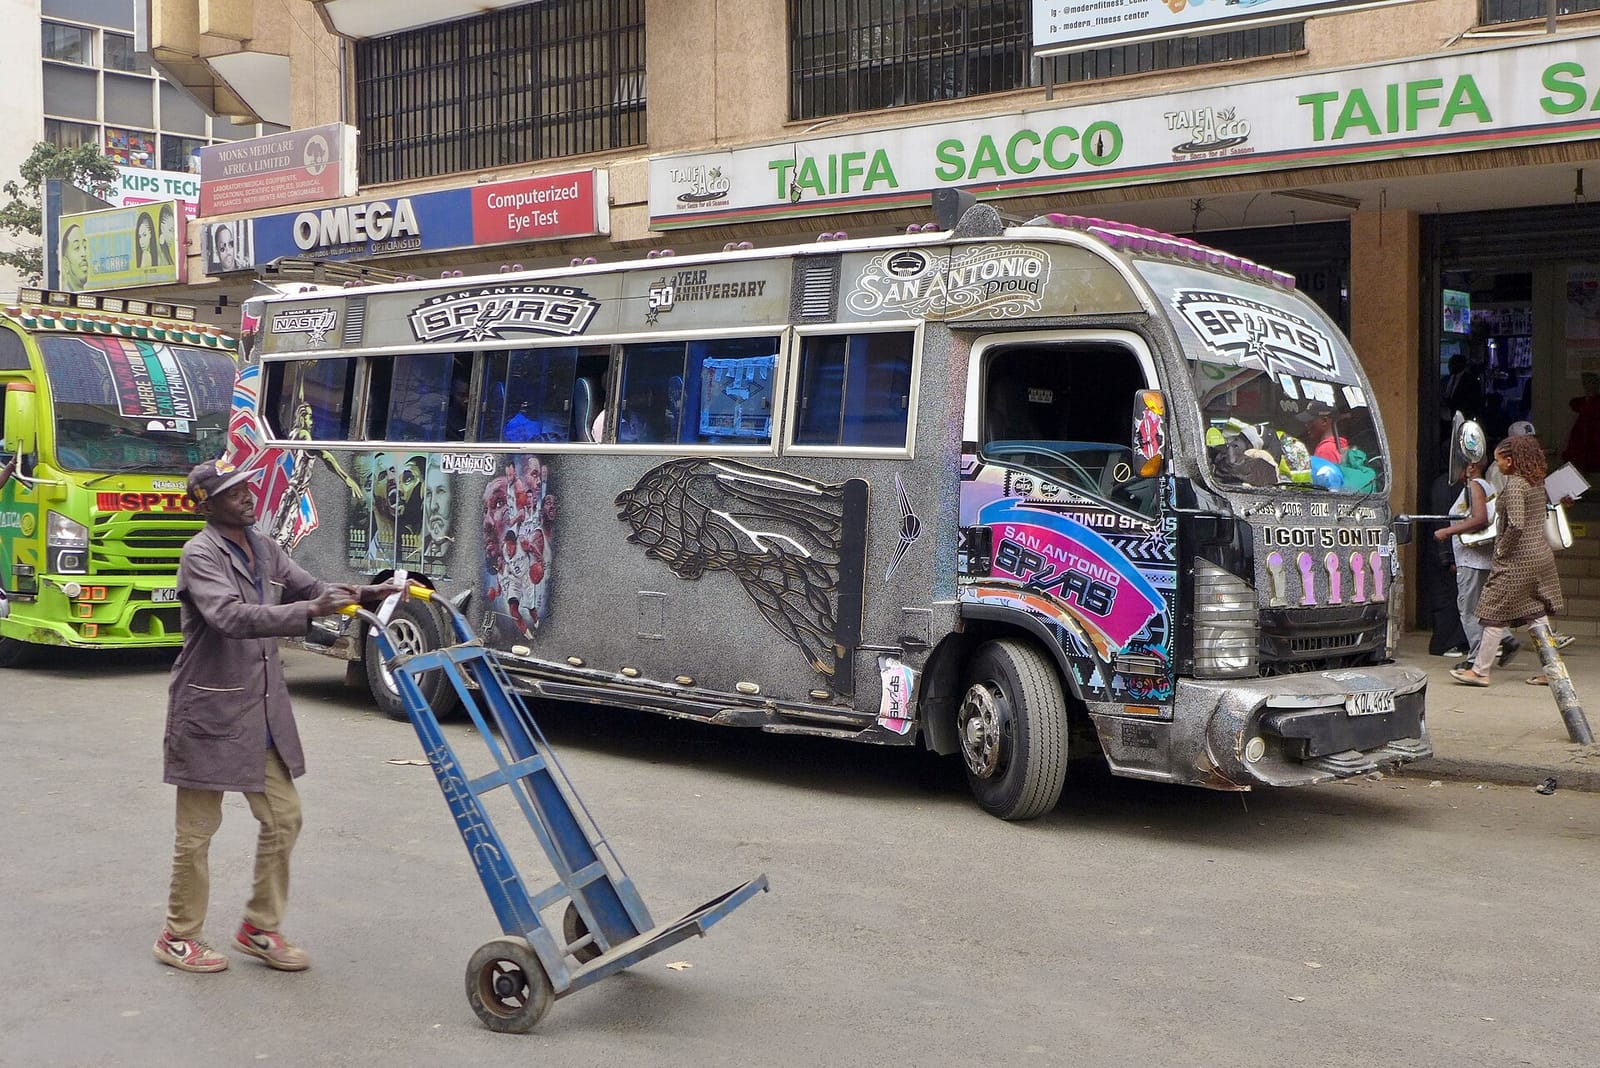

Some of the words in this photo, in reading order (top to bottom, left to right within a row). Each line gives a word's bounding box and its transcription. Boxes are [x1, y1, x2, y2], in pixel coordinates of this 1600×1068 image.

[1124, 11, 1149, 21] center
[1298, 74, 1493, 141] TAIFA
[1541, 61, 1600, 115] S
[1164, 107, 1214, 130] TAIFA
[1192, 118, 1251, 144] SACCO
[250, 140, 295, 157] MEDICARE
[223, 162, 253, 176] AFRICA
[255, 156, 290, 171] LIMITED
[769, 148, 899, 200] TAIFA
[935, 121, 1123, 181] SACCO
[122, 174, 159, 192] KIPS
[670, 165, 706, 184] TAIFA
[690, 176, 730, 195] SACCO
[487, 181, 579, 210] Computerized
[293, 198, 421, 251] OMEGA
[508, 212, 531, 230] Eye
[533, 210, 559, 226] Test
[371, 240, 407, 252] OPTICIANS
[408, 239, 421, 249] LTD
[677, 270, 707, 286] YEAR
[848, 275, 921, 311] SAN
[924, 257, 1042, 298] ANTONIO
[432, 292, 470, 304] SAN
[480, 287, 575, 296] ANTONIO
[649, 286, 673, 308] 50
[674, 280, 766, 301] ANNIVERSARY
[423, 300, 580, 334] SPURS
[1189, 293, 1220, 302] SAN
[1227, 298, 1301, 324] ANTONIO
[1195, 310, 1321, 356] SPURS
[136, 381, 158, 415] WHERE
[165, 367, 191, 417] ANYTHING
[157, 396, 174, 416] CAN
[1282, 502, 1302, 516] 2003
[1311, 503, 1329, 516] 2014
[1264, 526, 1272, 545] I
[1276, 527, 1316, 546] GOT
[1320, 528, 1334, 548] 5
[1339, 528, 1362, 546] ON
[1366, 528, 1381, 546] IT
[1004, 526, 1041, 551] SAN
[1043, 544, 1121, 586] ANTONIO
